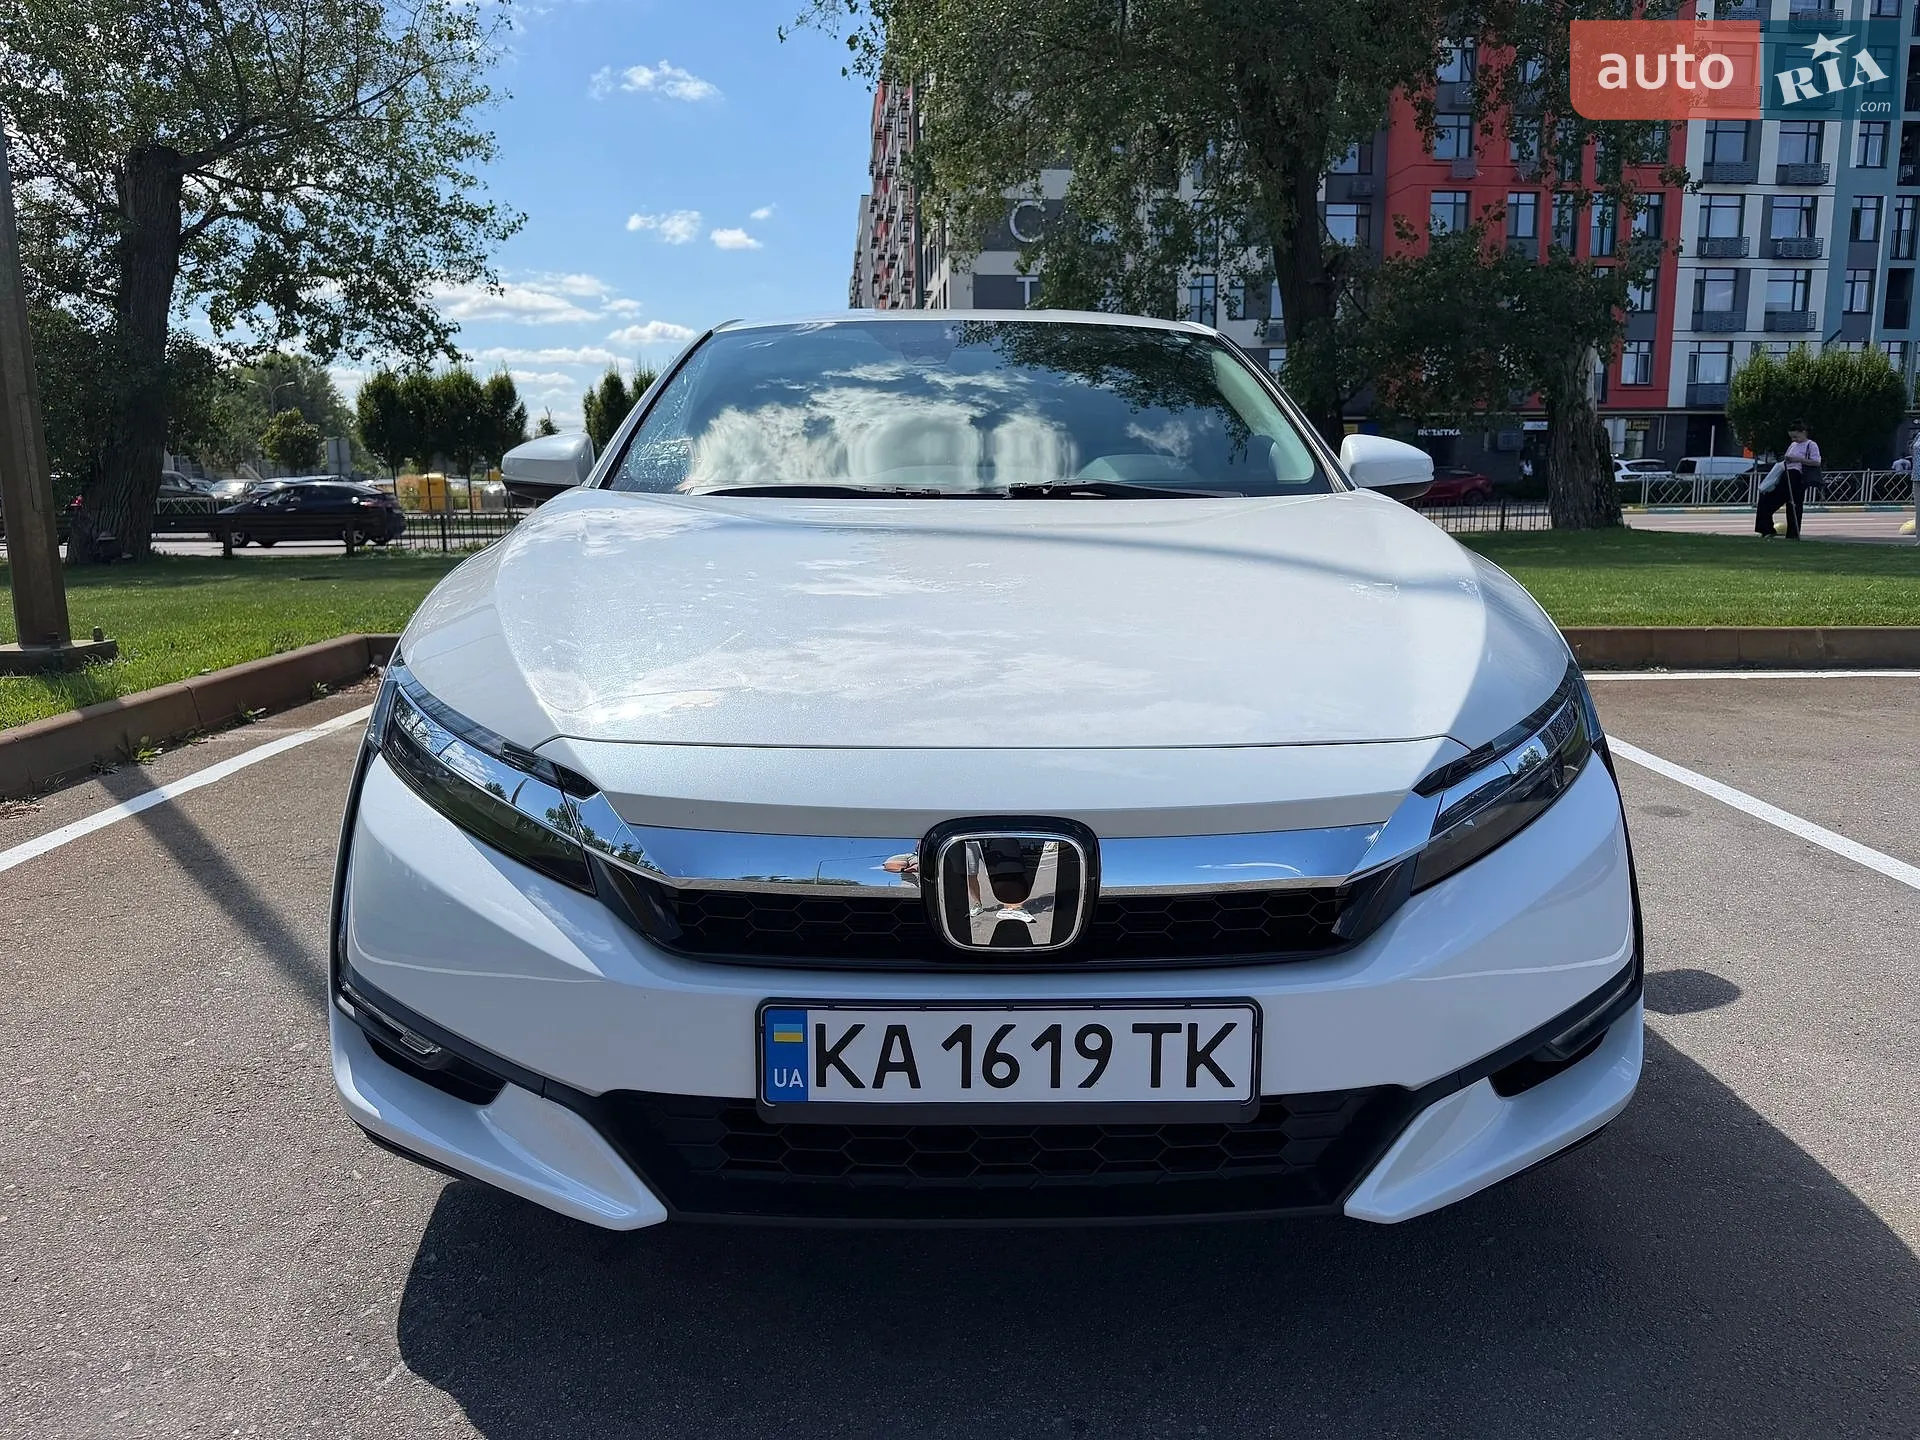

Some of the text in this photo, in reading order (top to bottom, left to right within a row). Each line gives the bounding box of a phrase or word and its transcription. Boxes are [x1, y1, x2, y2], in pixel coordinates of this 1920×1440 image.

[815, 1022, 1238, 1089] KA 1619 TK
[774, 1068, 804, 1089] UA
